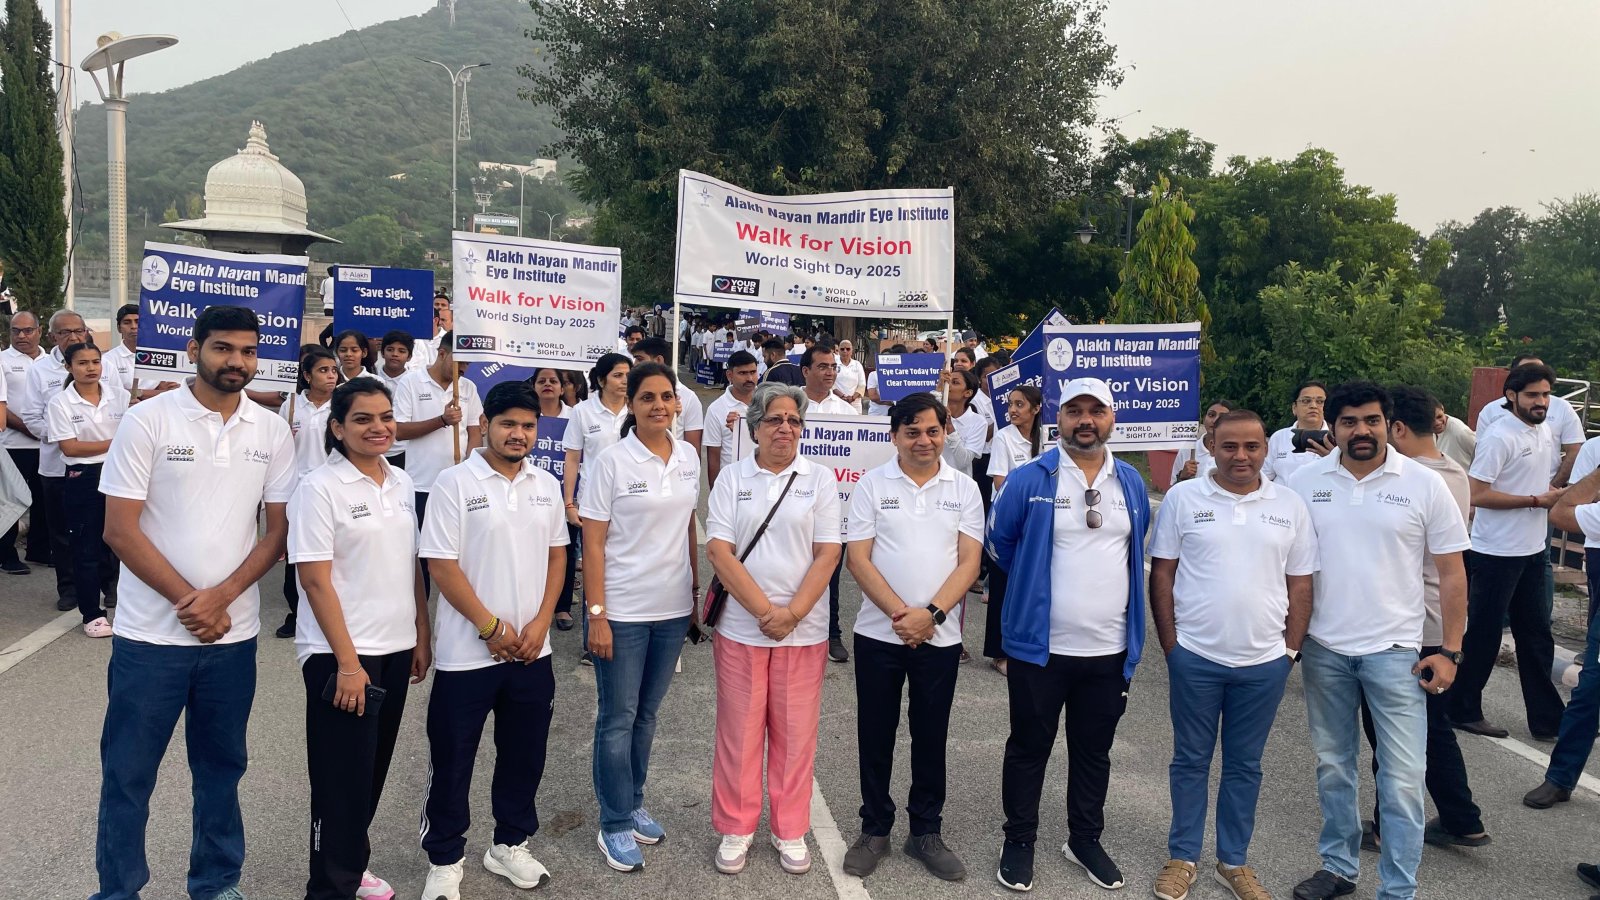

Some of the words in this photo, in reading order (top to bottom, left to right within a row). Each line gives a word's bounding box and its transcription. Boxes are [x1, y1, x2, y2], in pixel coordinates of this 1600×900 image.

[724, 196, 764, 214] Alakh
[768, 207, 812, 224] Nayan
[816, 208, 866, 224] Mandir
[869, 208, 893, 223] Eye
[898, 206, 949, 221] Institute
[736, 222, 792, 248] Walk
[800, 234, 834, 252] for
[840, 237, 912, 256] Vision
[486, 249, 524, 265] Alakh
[528, 252, 568, 269] Nayan
[572, 257, 618, 273] Mandir
[746, 251, 789, 268] World
[794, 258, 830, 274] Sight
[834, 264, 862, 278] Day
[867, 265, 901, 277] 2025
[172, 260, 214, 278] Alakh
[218, 265, 260, 282] Nayan
[486, 266, 508, 280] Eye
[513, 268, 566, 284] Institute
[170, 277, 196, 292] Eye
[200, 280, 259, 298] Institute
[731, 286, 755, 294] EYES
[732, 279, 757, 288] YOUR
[385, 288, 413, 300] Sight,
[468, 286, 512, 305] Walk
[517, 292, 544, 308] for
[549, 294, 605, 312] Vision
[826, 288, 857, 296] WORLD
[825, 296, 850, 304] SIGHT
[853, 297, 870, 306] DAY
[149, 300, 198, 319] Walk
[253, 310, 298, 328] sion
[353, 305, 380, 316] Share
[476, 309, 508, 322] World
[512, 313, 542, 326] Sight
[545, 317, 566, 328] Day
[570, 318, 596, 328] 2025
[156, 324, 192, 337] World
[258, 334, 287, 346] 2025
[537, 342, 564, 350] WORLD
[1076, 338, 1110, 351] Alakh
[1114, 338, 1154, 352] Nayan
[1158, 338, 1200, 350] Mandir
[150, 352, 174, 360] YOUR
[1076, 356, 1098, 368] Eye
[1102, 355, 1152, 367] Institute
[480, 362, 500, 378] Live
[1134, 378, 1189, 392] Vision
[1112, 399, 1130, 411] ght
[1133, 400, 1153, 410] Day
[1156, 399, 1180, 408] 2025
[814, 427, 853, 442] Nayan
[857, 429, 892, 442] Mand
[253, 450, 271, 460] Alak
[800, 443, 851, 457] Institute
[834, 468, 866, 482] Vis
[838, 492, 850, 501] ay
[1385, 493, 1411, 505] Alakh
[1268, 514, 1292, 525] Alakh
